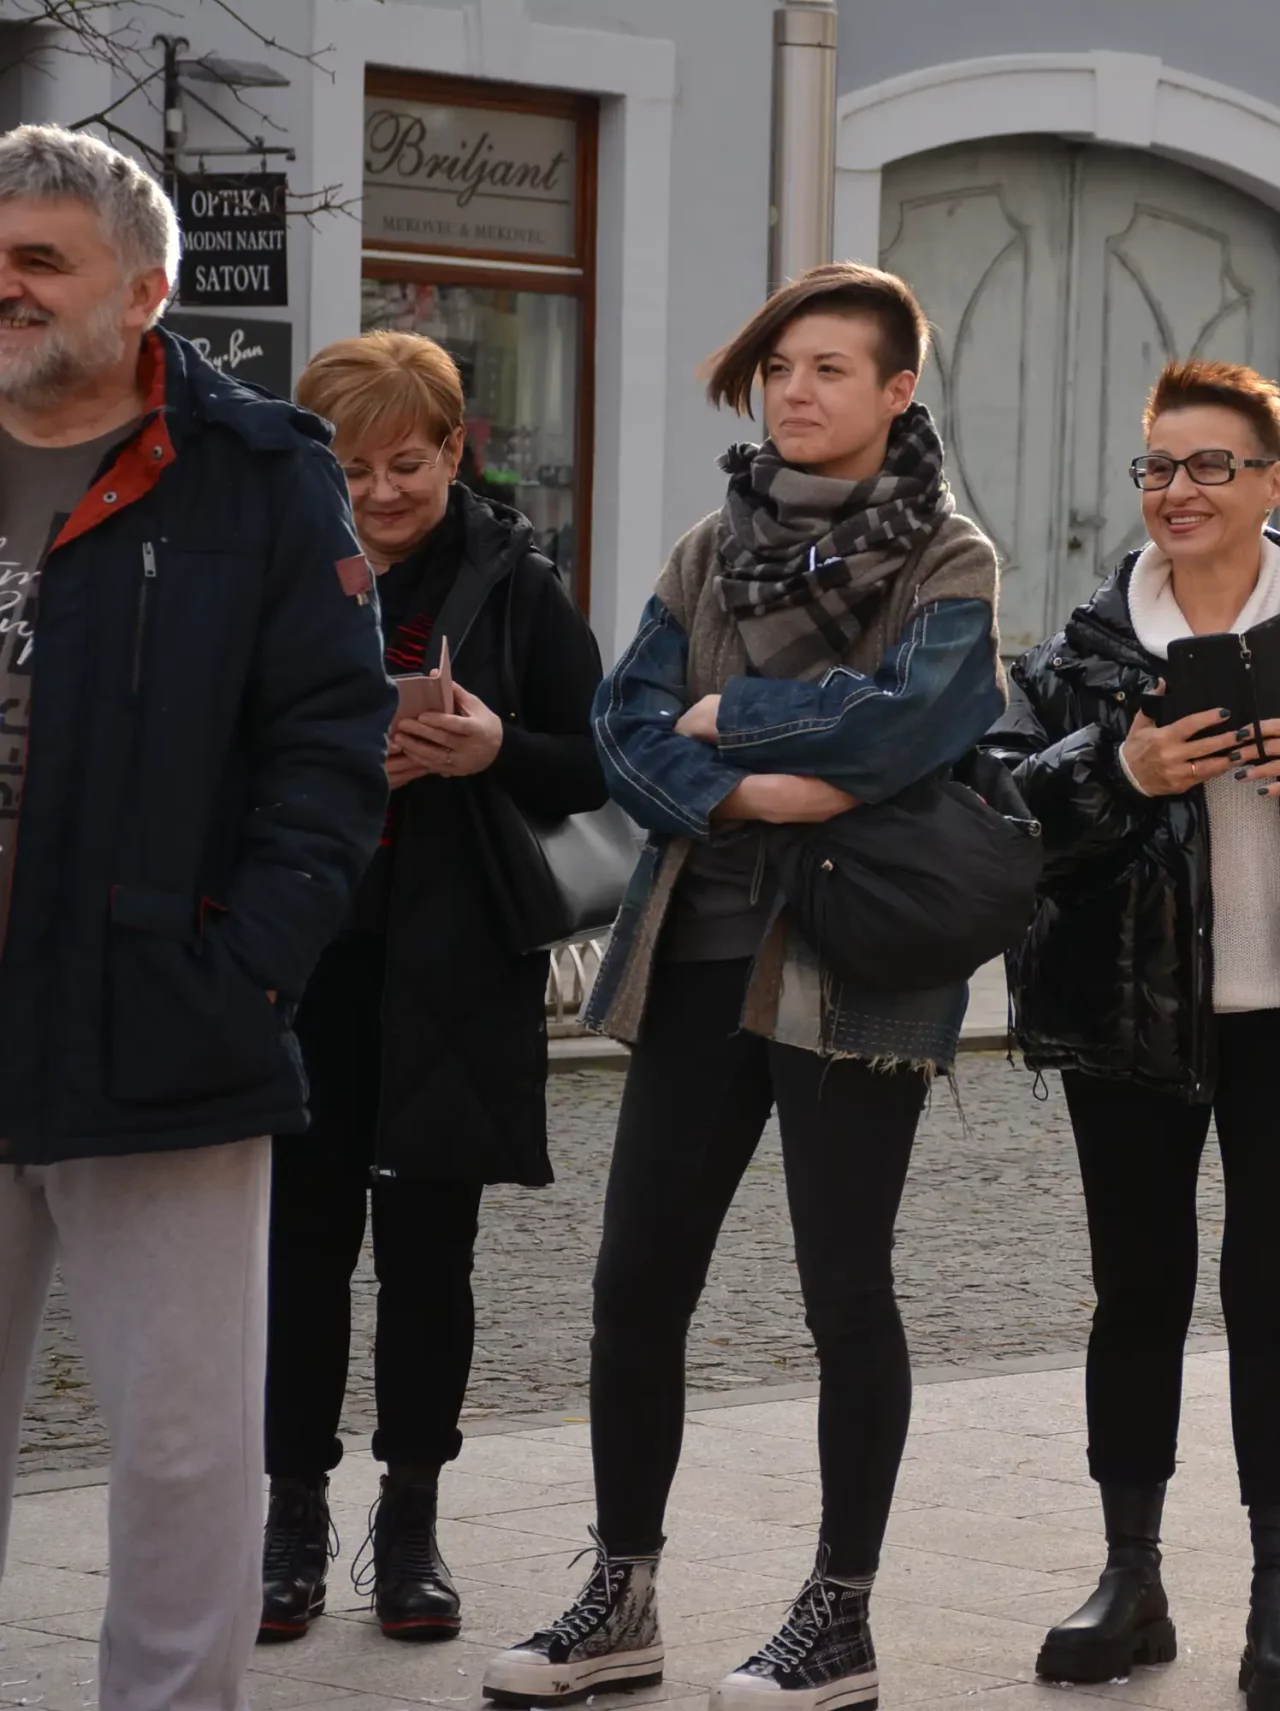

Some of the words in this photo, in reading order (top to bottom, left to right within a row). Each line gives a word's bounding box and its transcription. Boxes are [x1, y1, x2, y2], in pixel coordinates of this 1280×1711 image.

[365, 109, 569, 208] Briljant
[191, 189, 271, 217] OPTIKA
[182, 230, 232, 250] MODNI
[236, 229, 285, 249] NAKIT
[195, 264, 271, 292] SATOVI
